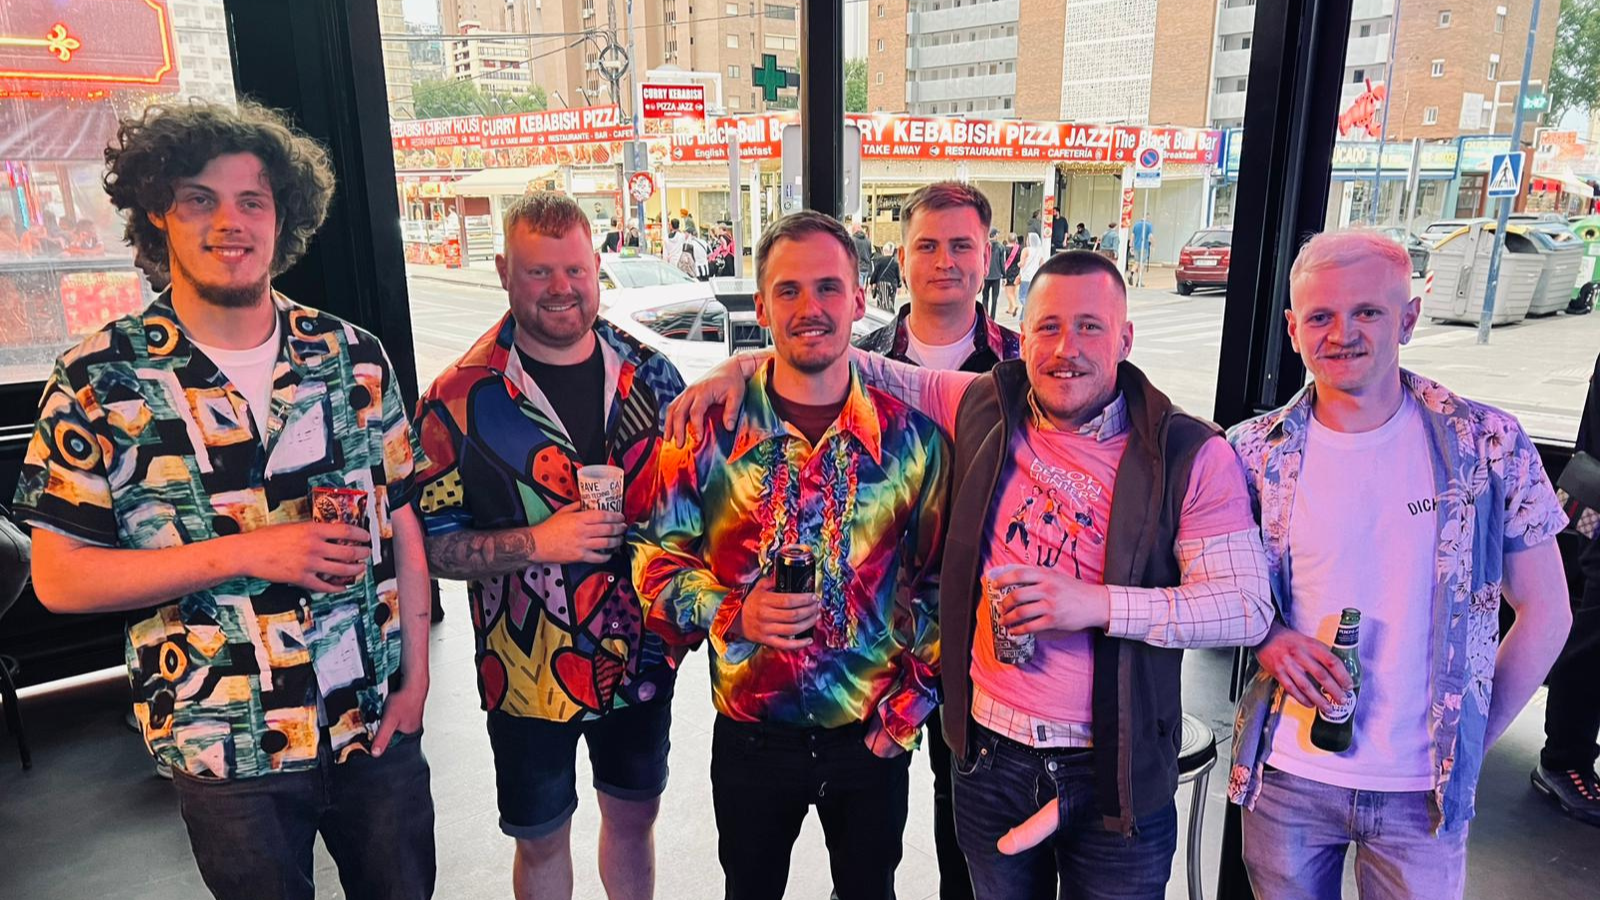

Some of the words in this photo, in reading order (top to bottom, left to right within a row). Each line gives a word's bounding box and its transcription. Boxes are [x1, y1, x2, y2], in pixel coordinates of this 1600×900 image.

[656, 102, 676, 111] PIZZA
[677, 103, 694, 111] JAZZ
[425, 119, 453, 136] CURRY
[481, 116, 517, 137] CURRY
[519, 110, 580, 133] KEBABISH
[583, 107, 621, 129] PIZZA
[594, 130, 608, 140] BAR
[737, 119, 765, 143] Bull
[894, 120, 1000, 145] KEBABISH
[1006, 124, 1060, 147] PIZZA
[1065, 127, 1109, 148] JAZZ
[1115, 129, 1136, 149] The
[1139, 129, 1171, 150] Black
[1173, 131, 1196, 151] Bull
[1198, 131, 1217, 151] Bar
[694, 147, 725, 159] English
[862, 144, 891, 155] TAKE
[892, 145, 921, 156] AWAY
[945, 145, 1014, 157] RESTAURANTE
[1021, 147, 1040, 157] BAR
[1047, 147, 1093, 159] CAFETERÍA
